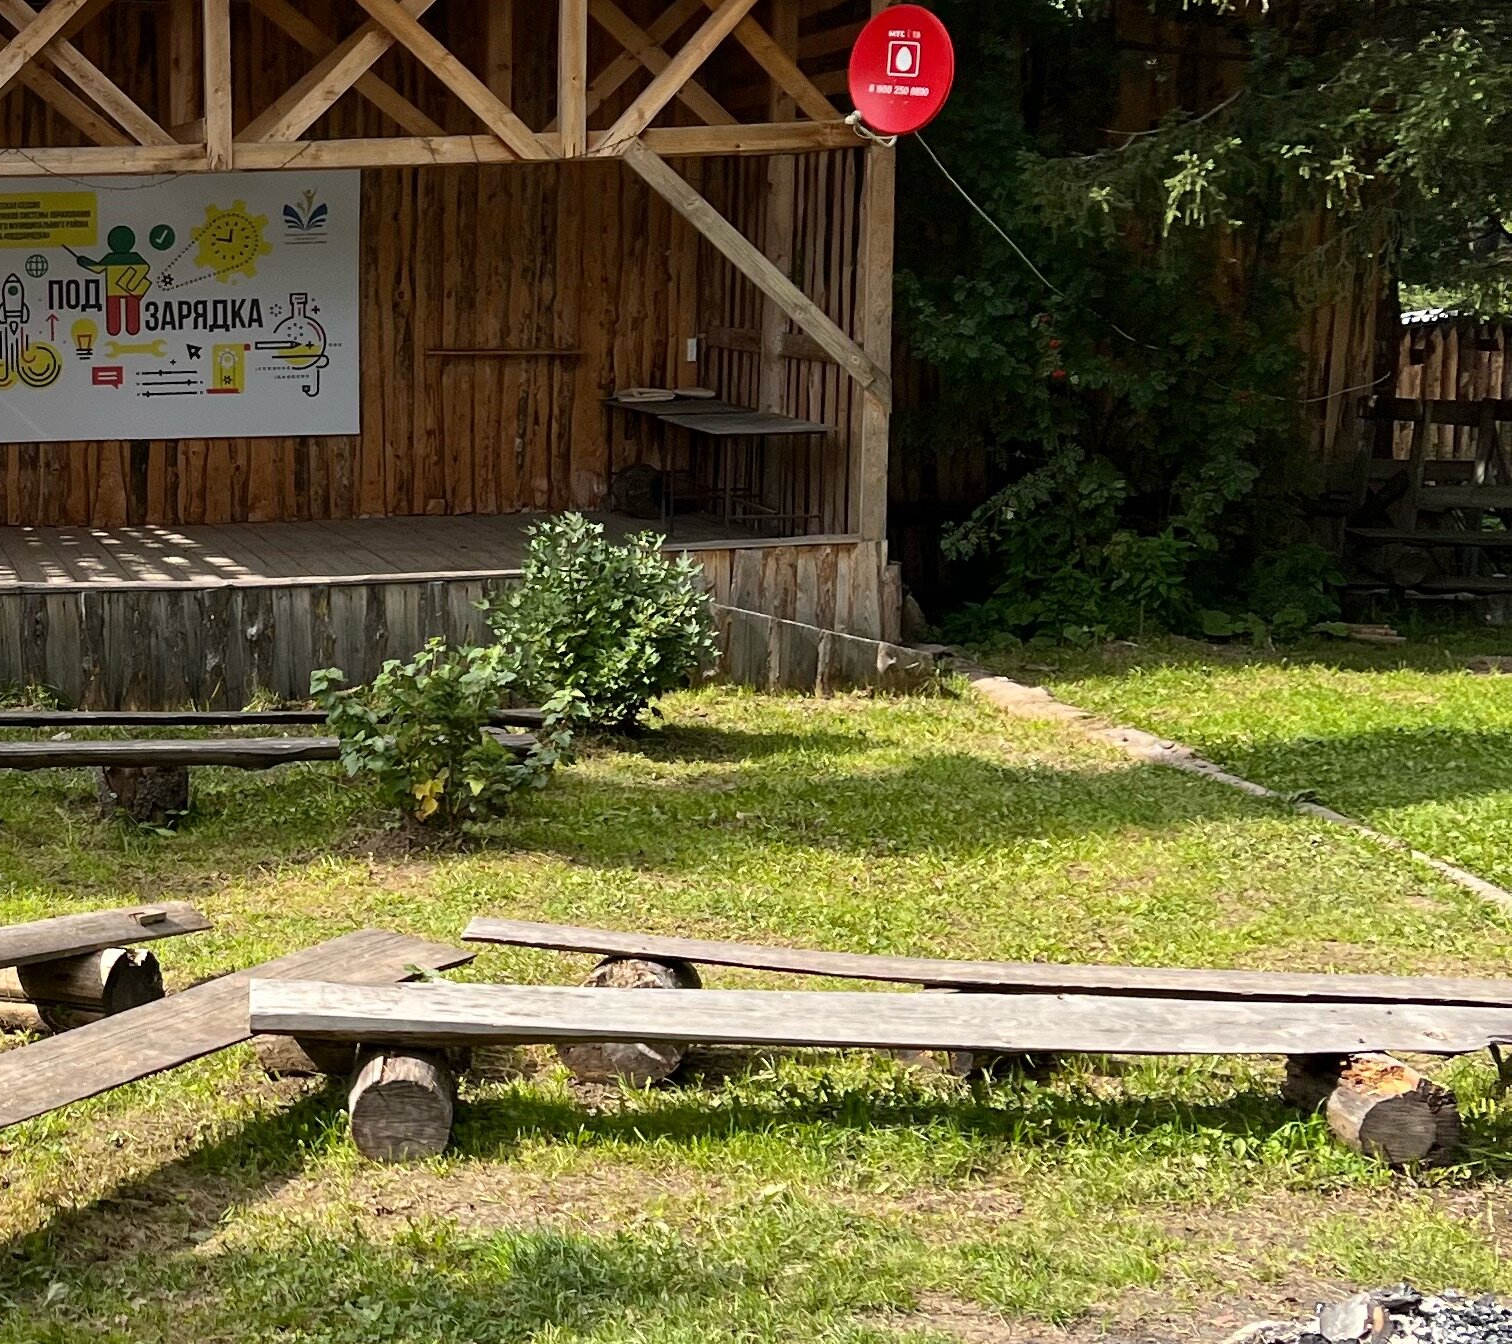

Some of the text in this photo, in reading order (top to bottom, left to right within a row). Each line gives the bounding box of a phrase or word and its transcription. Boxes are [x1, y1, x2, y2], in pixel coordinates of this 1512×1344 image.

[893, 85, 909, 95] 250
[48, 279, 102, 312] ПОД
[145, 299, 263, 332] ЗАРЯДКА
